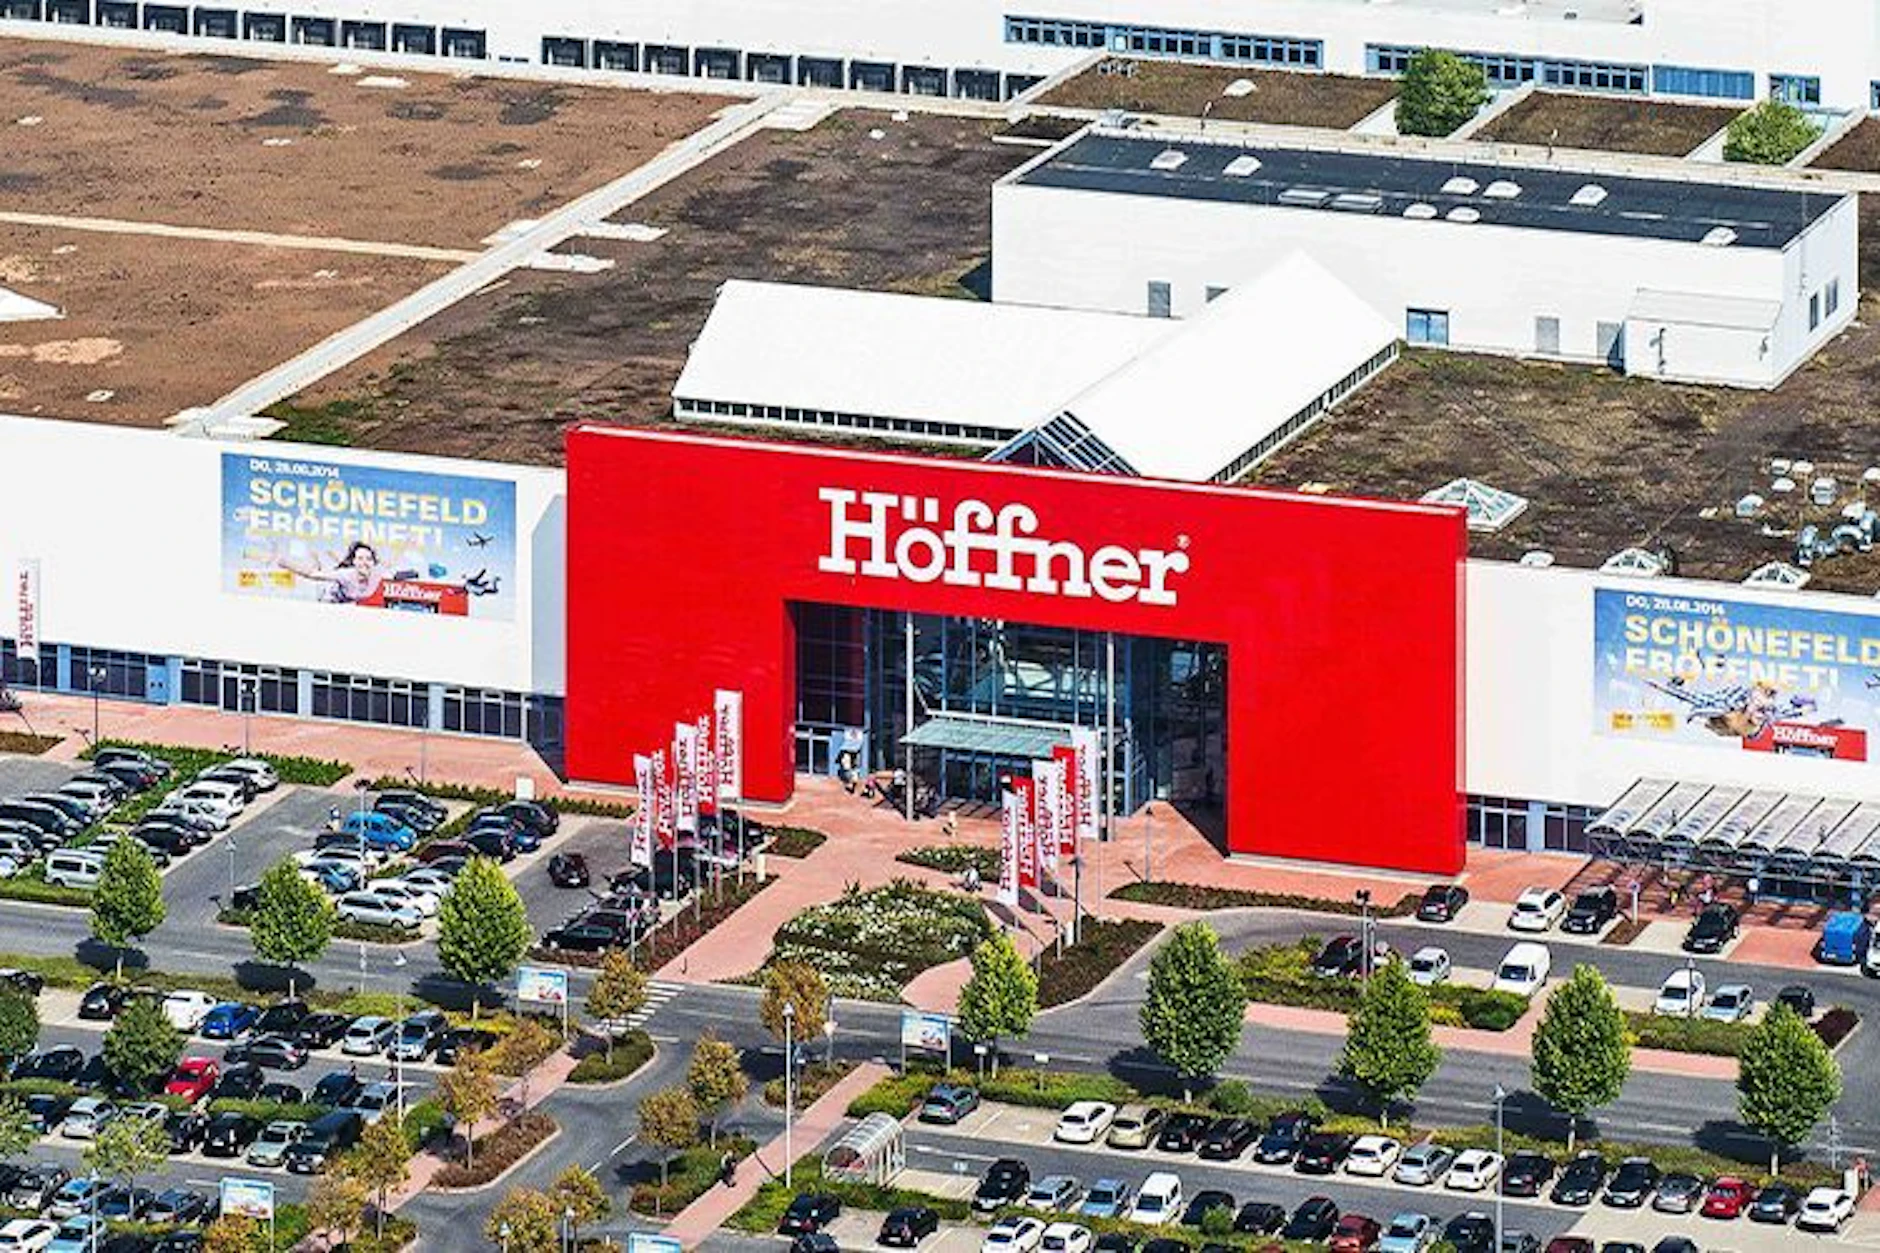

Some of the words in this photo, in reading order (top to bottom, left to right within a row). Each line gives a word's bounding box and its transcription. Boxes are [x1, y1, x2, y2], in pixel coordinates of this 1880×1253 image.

[249, 477, 488, 526] SCHÖNEFELD
[818, 487, 1190, 606] Höffner
[1625, 615, 1880, 667] SCHÖNEFELD
